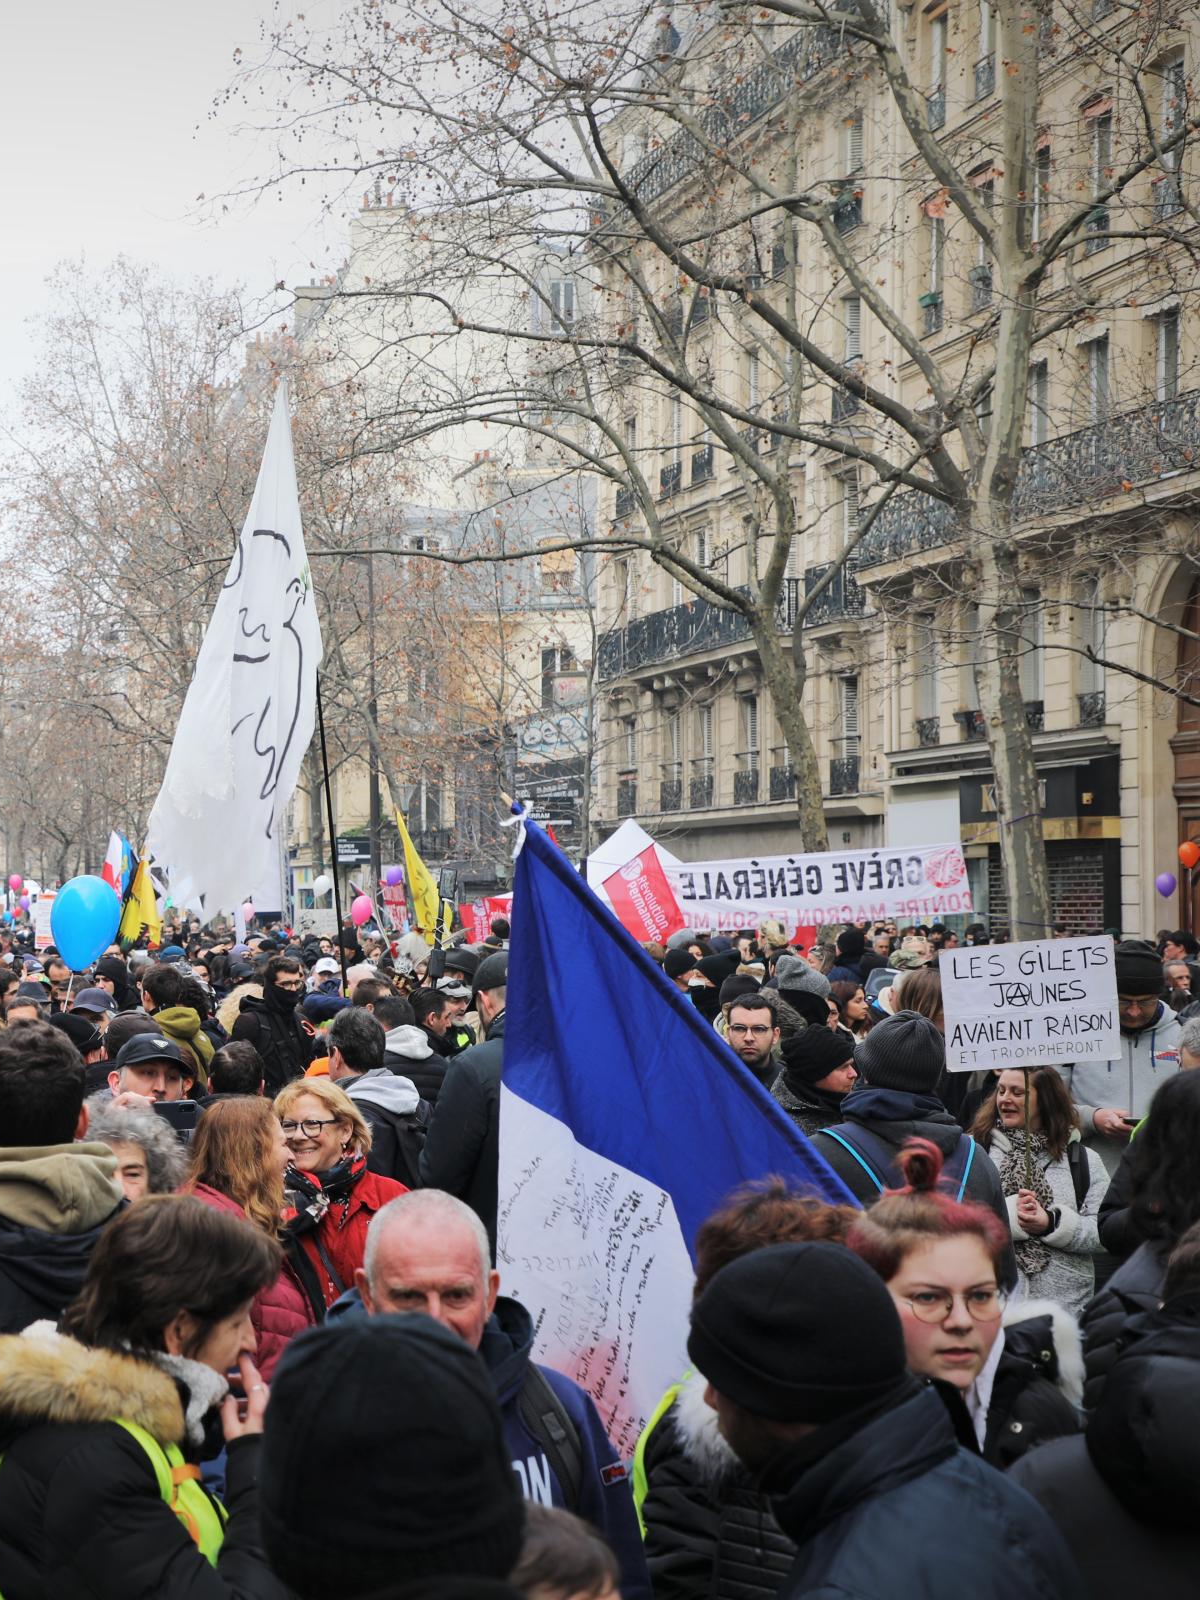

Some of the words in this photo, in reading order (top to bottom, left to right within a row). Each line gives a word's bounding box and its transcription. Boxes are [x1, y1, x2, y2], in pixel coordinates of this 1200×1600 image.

[626, 880, 663, 942] Permanente
[636, 874, 669, 929] Révolution
[953, 954, 1005, 980] LES
[989, 980, 1087, 1008] JAUNES
[959, 1050, 978, 1064] ET
[991, 1039, 1104, 1062] TRIOMPHERONT
